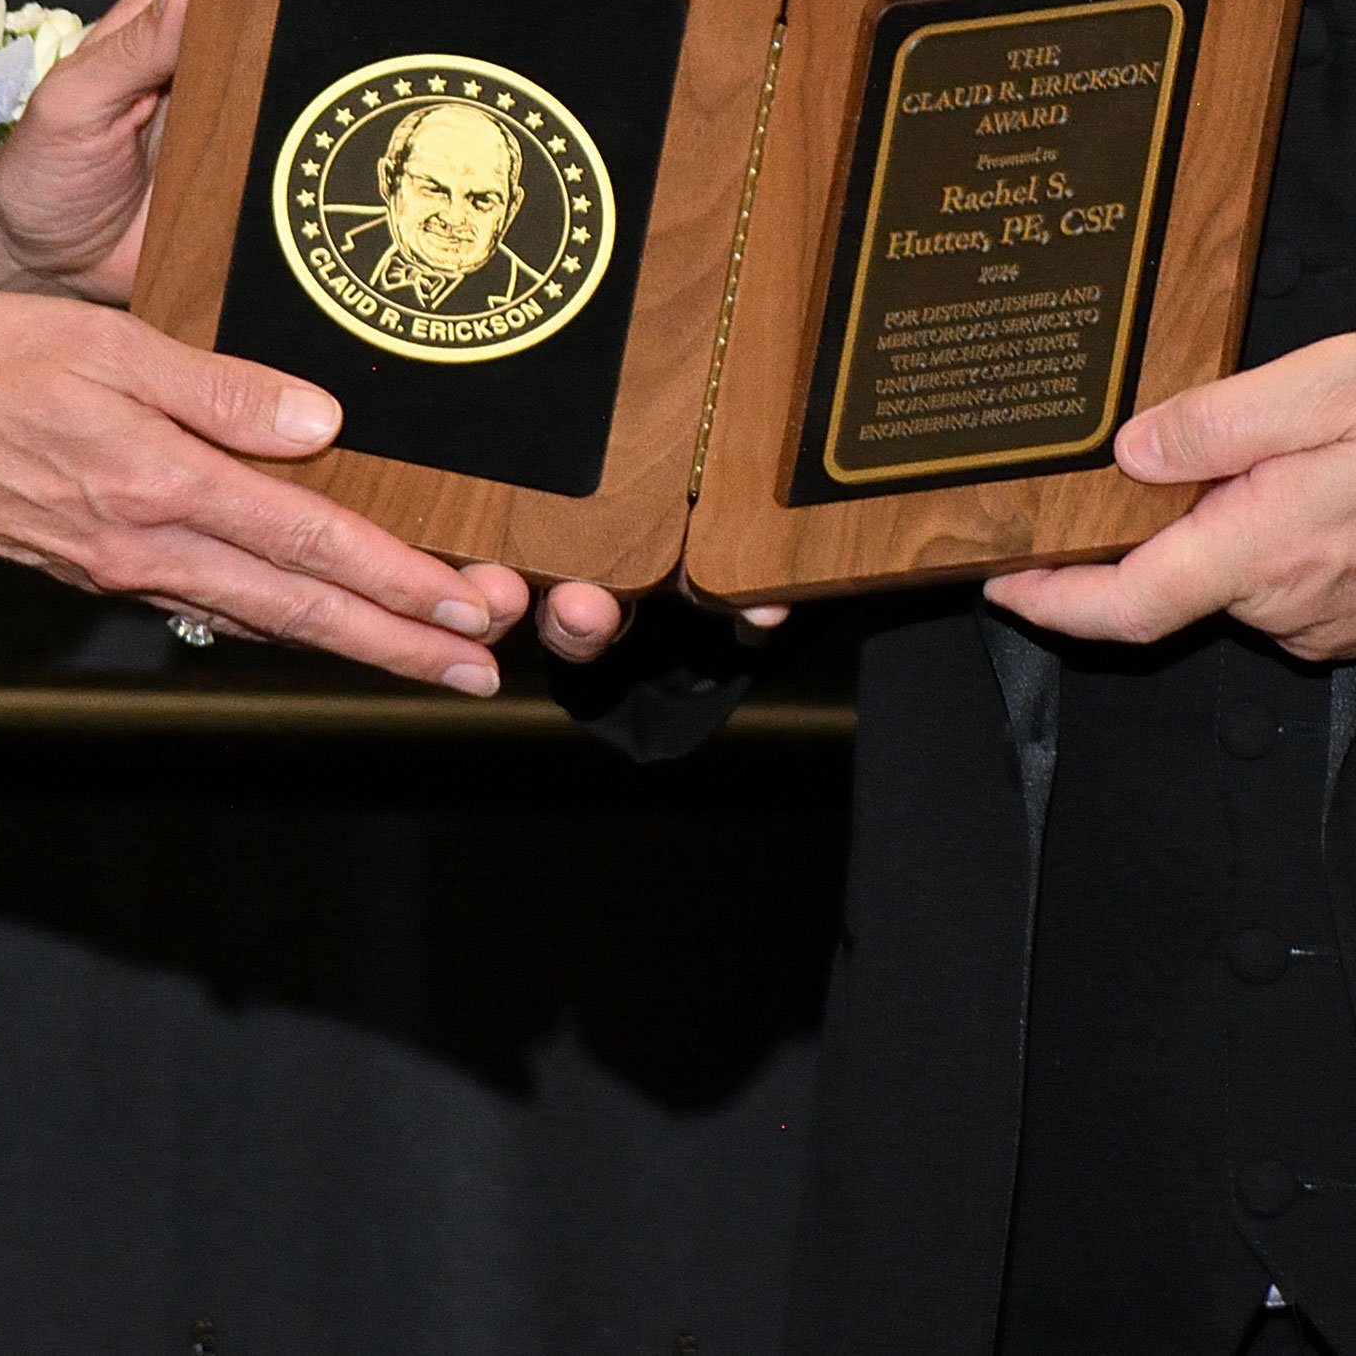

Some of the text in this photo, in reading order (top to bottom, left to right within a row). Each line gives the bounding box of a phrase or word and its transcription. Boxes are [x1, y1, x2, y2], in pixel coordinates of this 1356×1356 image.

[1007, 45, 1062, 71] THE
[902, 60, 1162, 114] CLAUD R. ERICKSON
[975, 104, 1070, 136] AWARD
[976, 147, 1042, 171] Presented
[939, 171, 1074, 215] Rachel S.
[885, 202, 1126, 260] Hutter, PE, CSP
[309, 246, 545, 341] CLAUD R. ERICKSON
[978, 263, 1020, 285] 2024
[876, 307, 1101, 351] MERITORIOUS SERVICE TO
[884, 285, 1102, 330] FOR DISTINGUISHED AND
[890, 332, 1081, 372] THE MICHIGAN STATE
[876, 353, 1087, 395] UNIVERSITY COLLEGE OF
[875, 377, 1079, 416] ENGINEERING AND THE
[859, 397, 1087, 441] ENGINEERING PROFESSION
